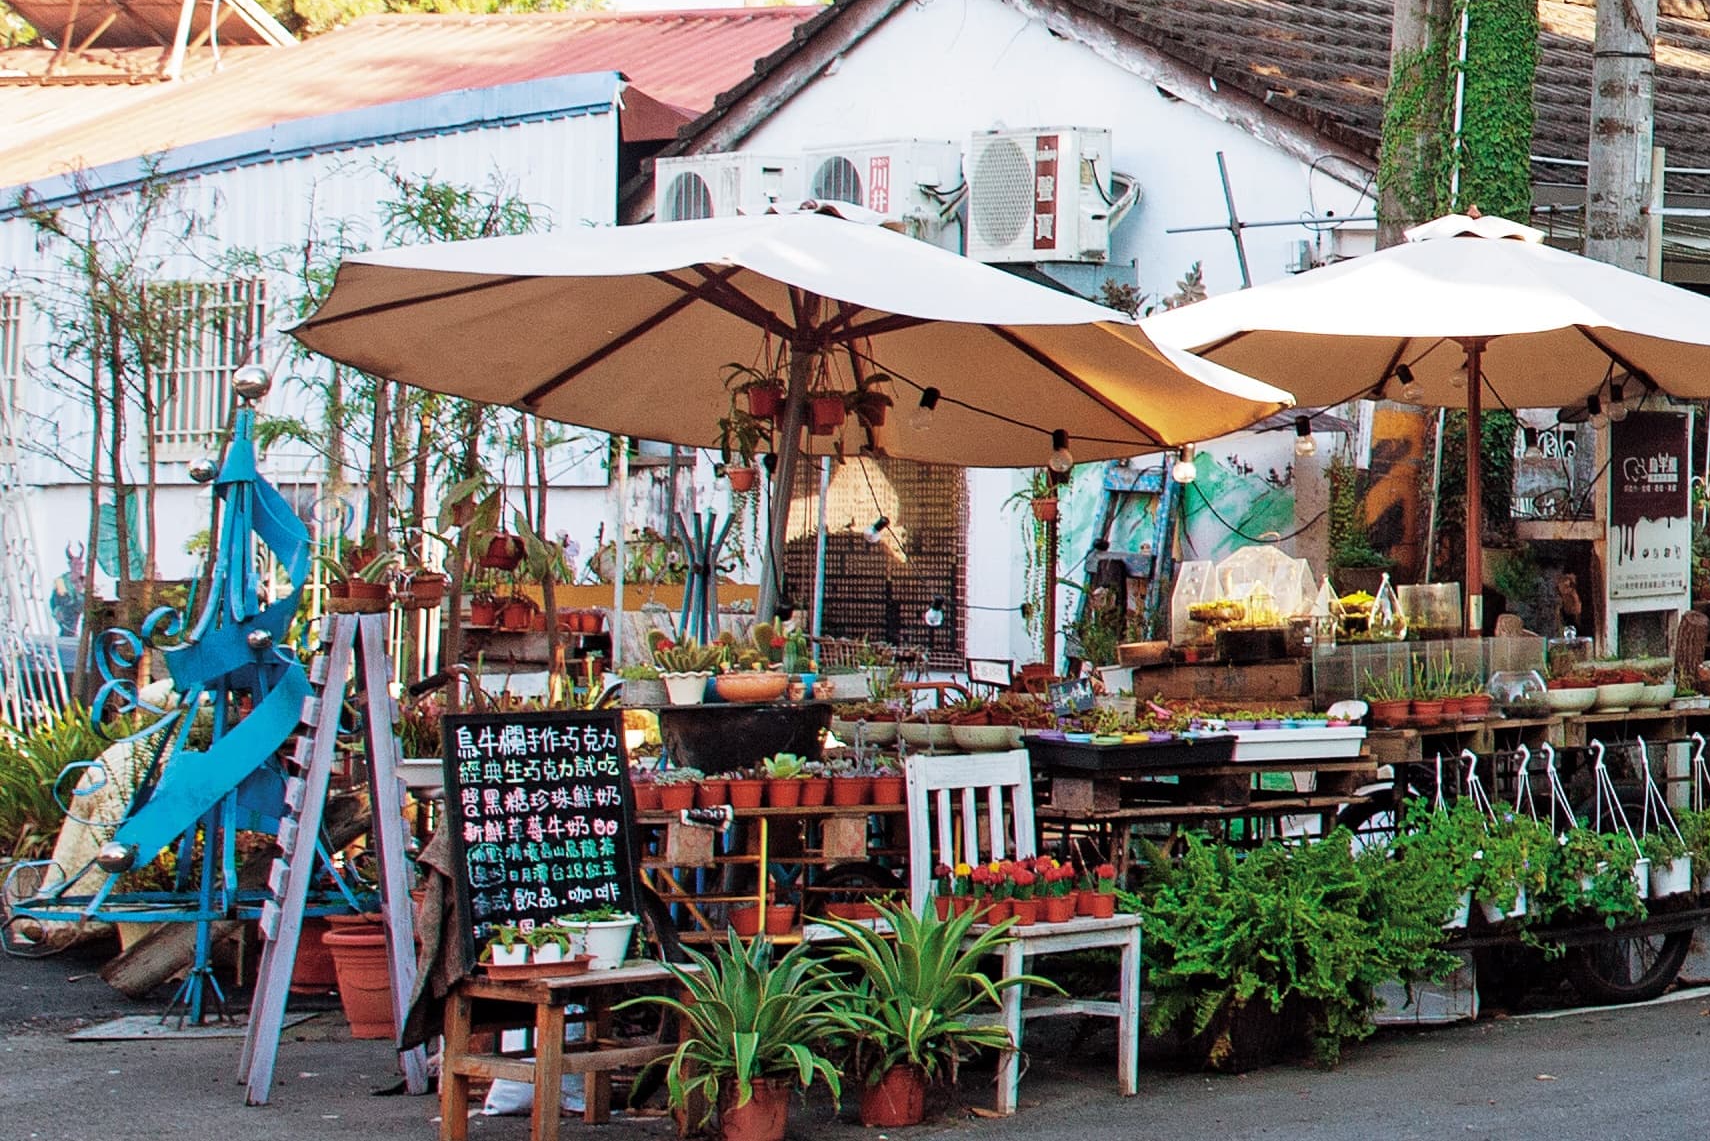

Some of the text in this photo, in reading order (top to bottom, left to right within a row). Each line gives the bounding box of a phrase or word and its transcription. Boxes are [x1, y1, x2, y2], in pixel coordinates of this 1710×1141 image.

[459, 753, 621, 785] 經典生巧克力試吃
